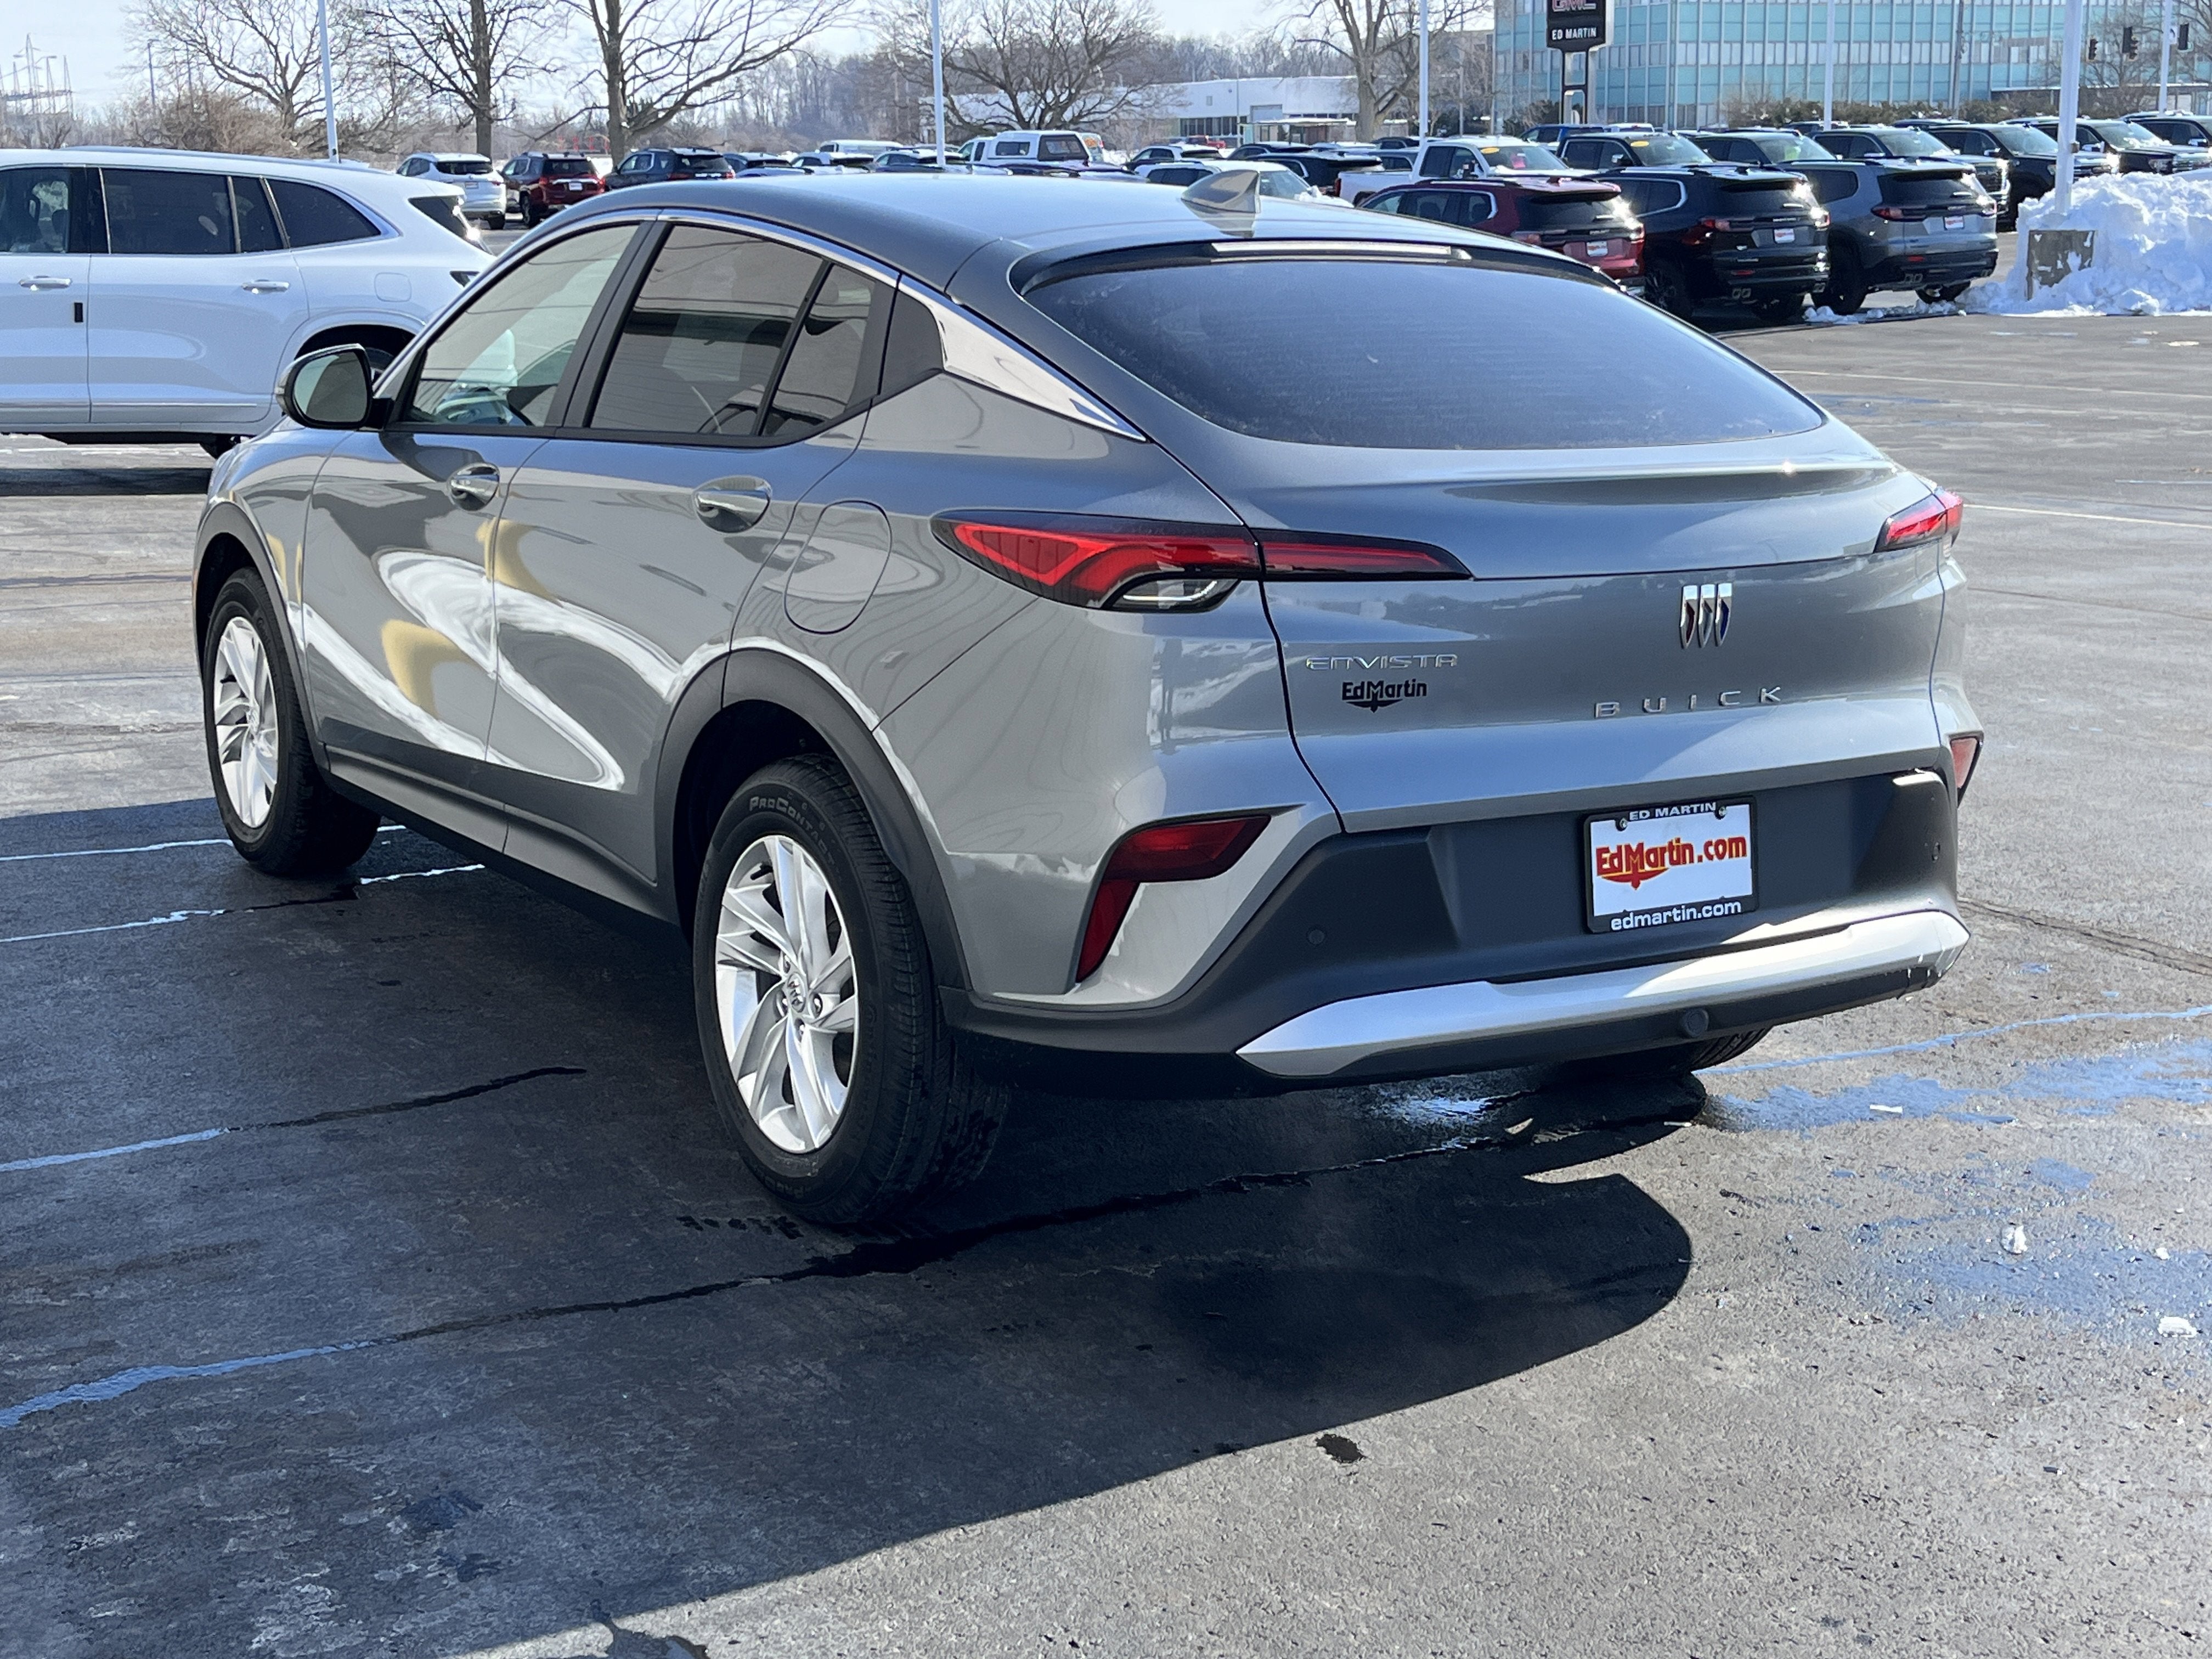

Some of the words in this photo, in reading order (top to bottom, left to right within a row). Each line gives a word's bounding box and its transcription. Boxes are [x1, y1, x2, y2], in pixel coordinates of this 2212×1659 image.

[1551, 29, 1563, 40] ED
[1565, 27, 1596, 39] MARTIN
[1306, 654, 1458, 670] ENVISTA
[1595, 687, 1781, 718] BUICK
[1629, 810, 1650, 821] ED
[1655, 802, 1717, 817] MARTIN
[1611, 901, 1742, 931] edmartin.com
